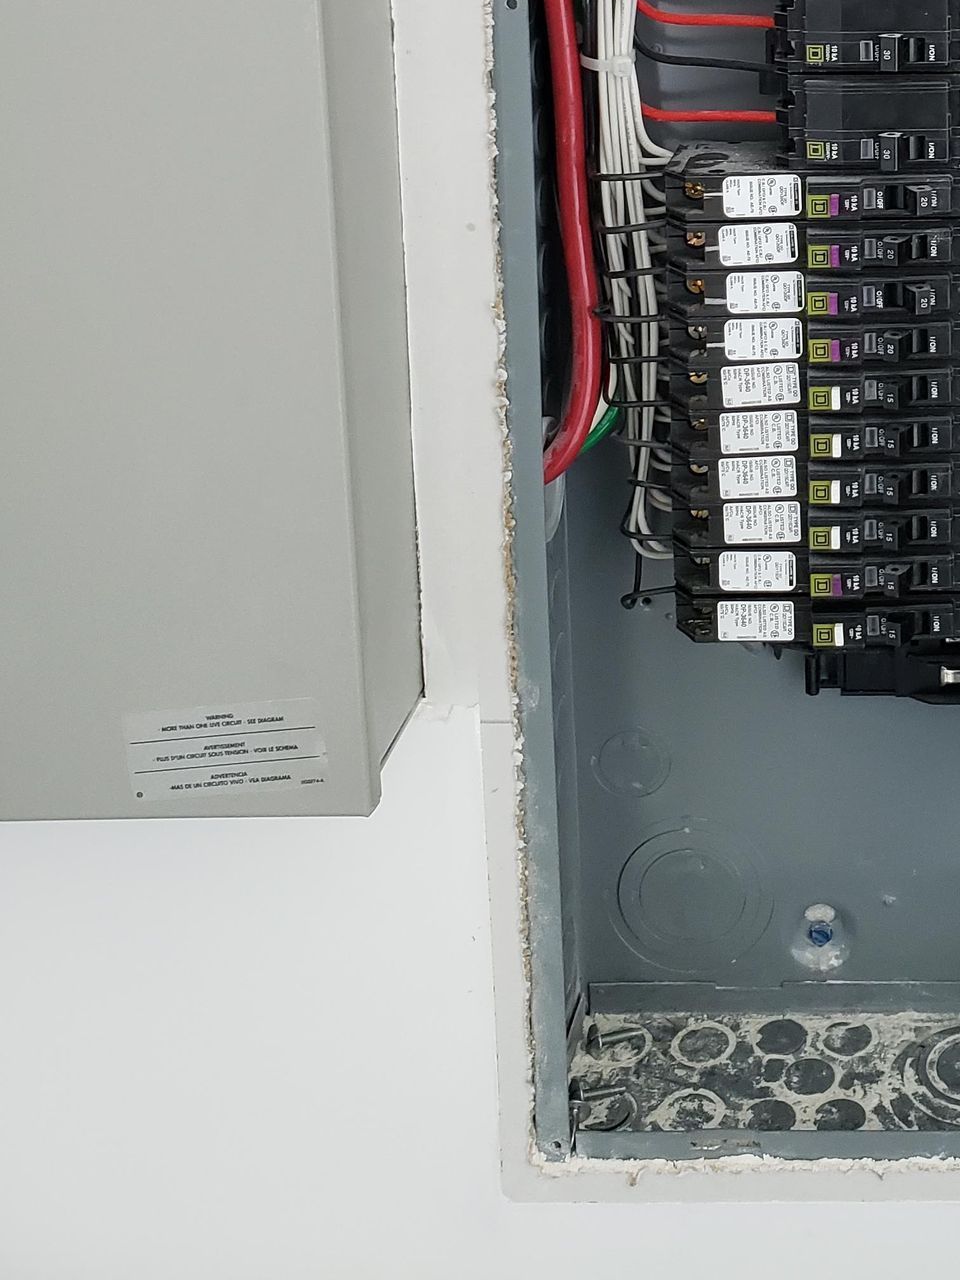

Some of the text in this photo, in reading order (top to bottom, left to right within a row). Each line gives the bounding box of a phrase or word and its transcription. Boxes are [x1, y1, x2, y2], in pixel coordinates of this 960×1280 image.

[883, 49, 891, 60] 30
[883, 149, 891, 160] 30
[921, 197, 928, 207] 20
[887, 249, 894, 259] 20
[921, 298, 928, 308] 20
[887, 345, 894, 355] 20
[887, 394, 894, 403] 15
[887, 439, 894, 449] 15
[887, 487, 894, 496] 15
[886, 533, 893, 542] 15
[888, 581, 895, 590] 15
[889, 630, 896, 639] 15
